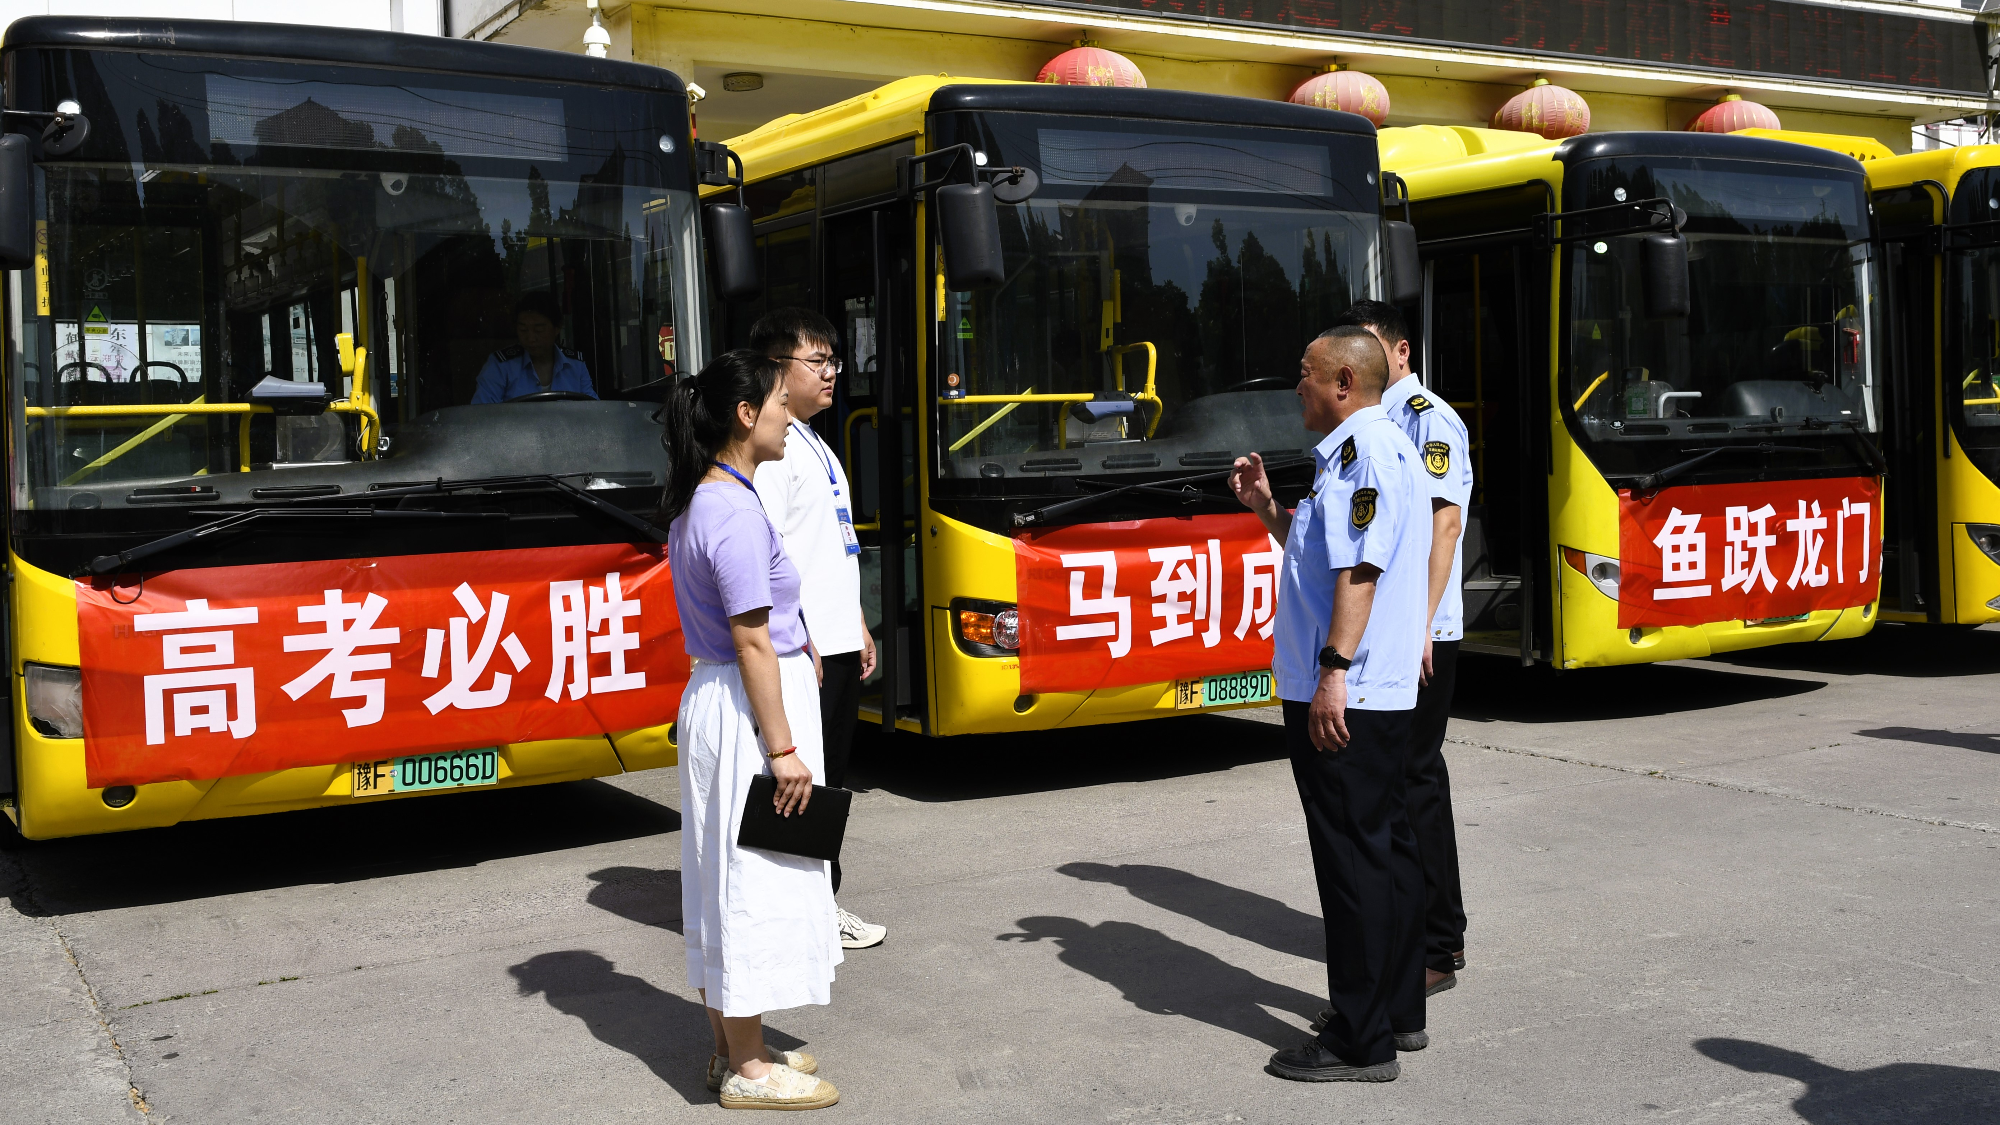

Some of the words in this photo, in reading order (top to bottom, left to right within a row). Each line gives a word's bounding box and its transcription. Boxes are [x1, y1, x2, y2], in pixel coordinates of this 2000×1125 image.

[1653, 496, 1871, 600] 鱼跃龙门
[133, 571, 647, 745] 高考必胜
[1179, 680, 1200, 705] 豫F
[1208, 674, 1270, 702] 08889D
[356, 760, 388, 791] 豫F
[402, 751, 496, 786] 00666D
